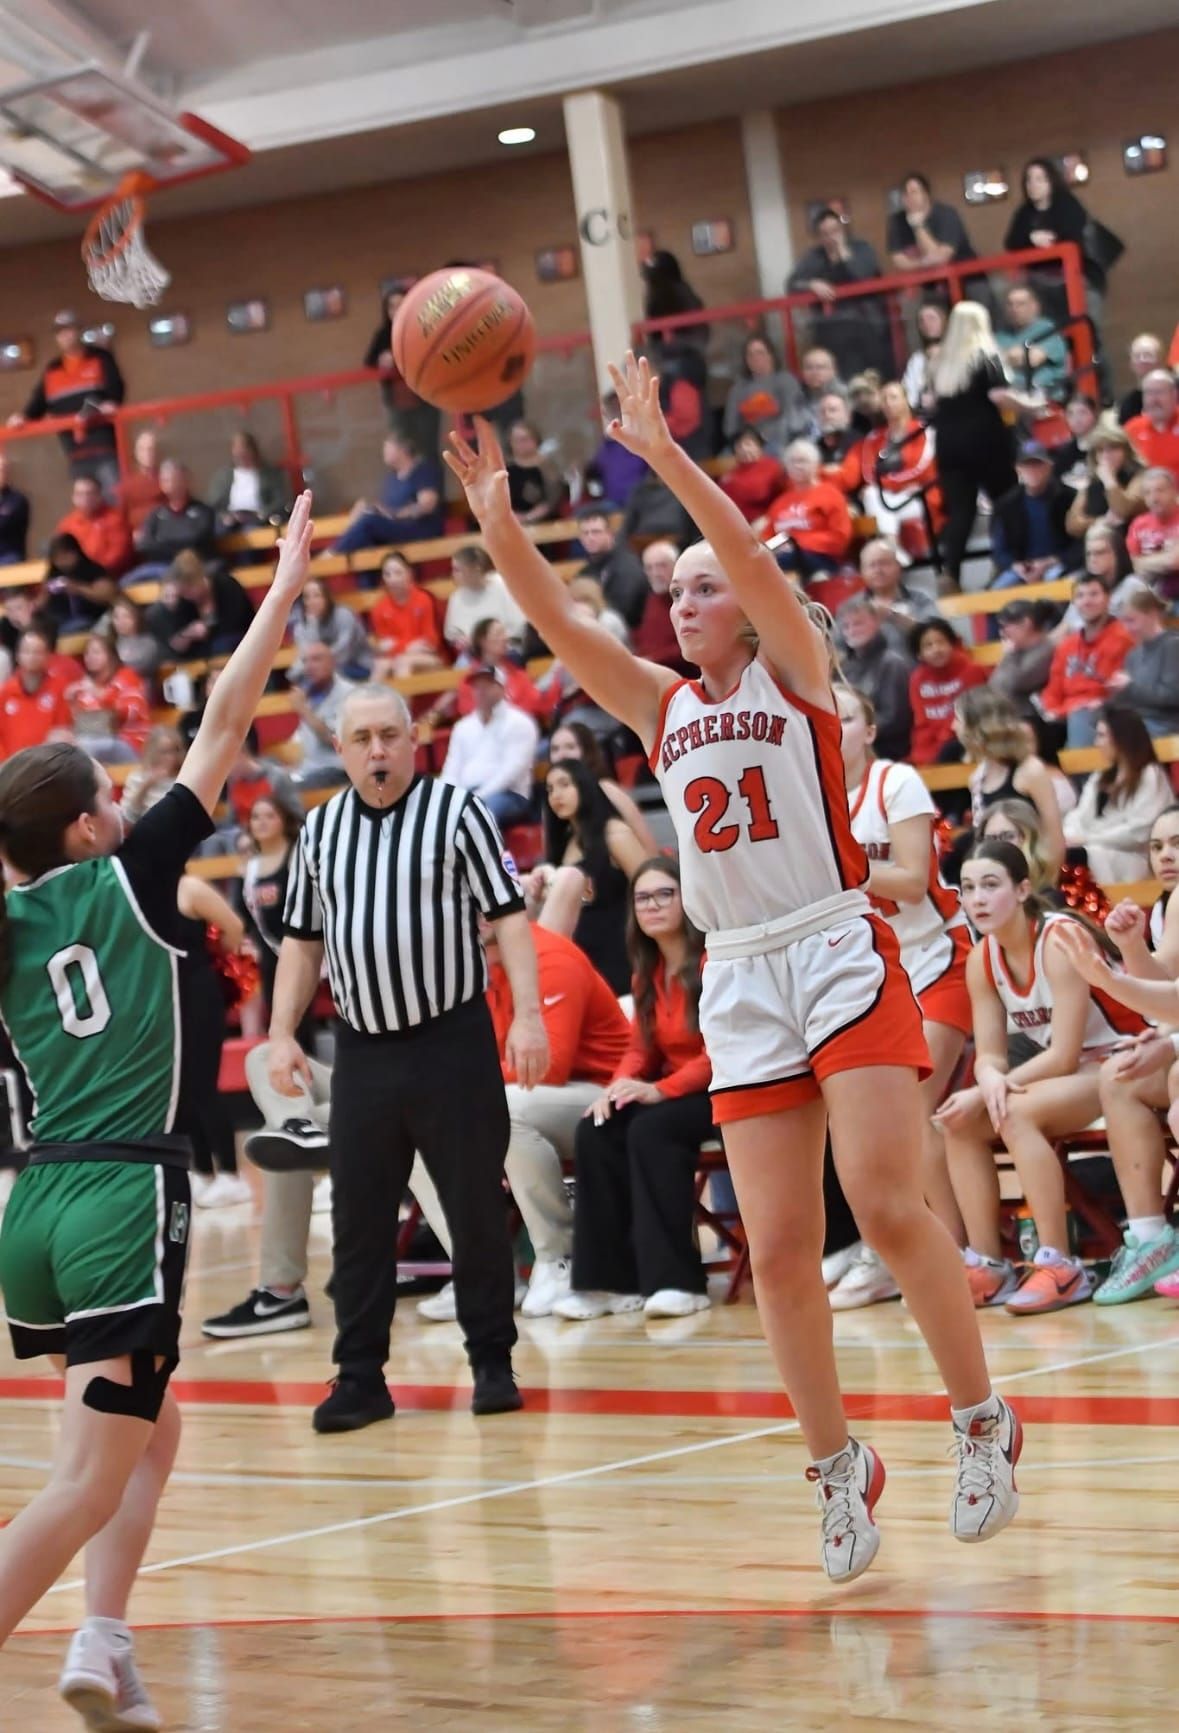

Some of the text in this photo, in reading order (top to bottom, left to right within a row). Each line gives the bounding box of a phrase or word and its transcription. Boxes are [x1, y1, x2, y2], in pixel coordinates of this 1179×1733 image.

[580, 208, 609, 247] C
[684, 765, 779, 853] 21
[45, 943, 112, 1040] 0
